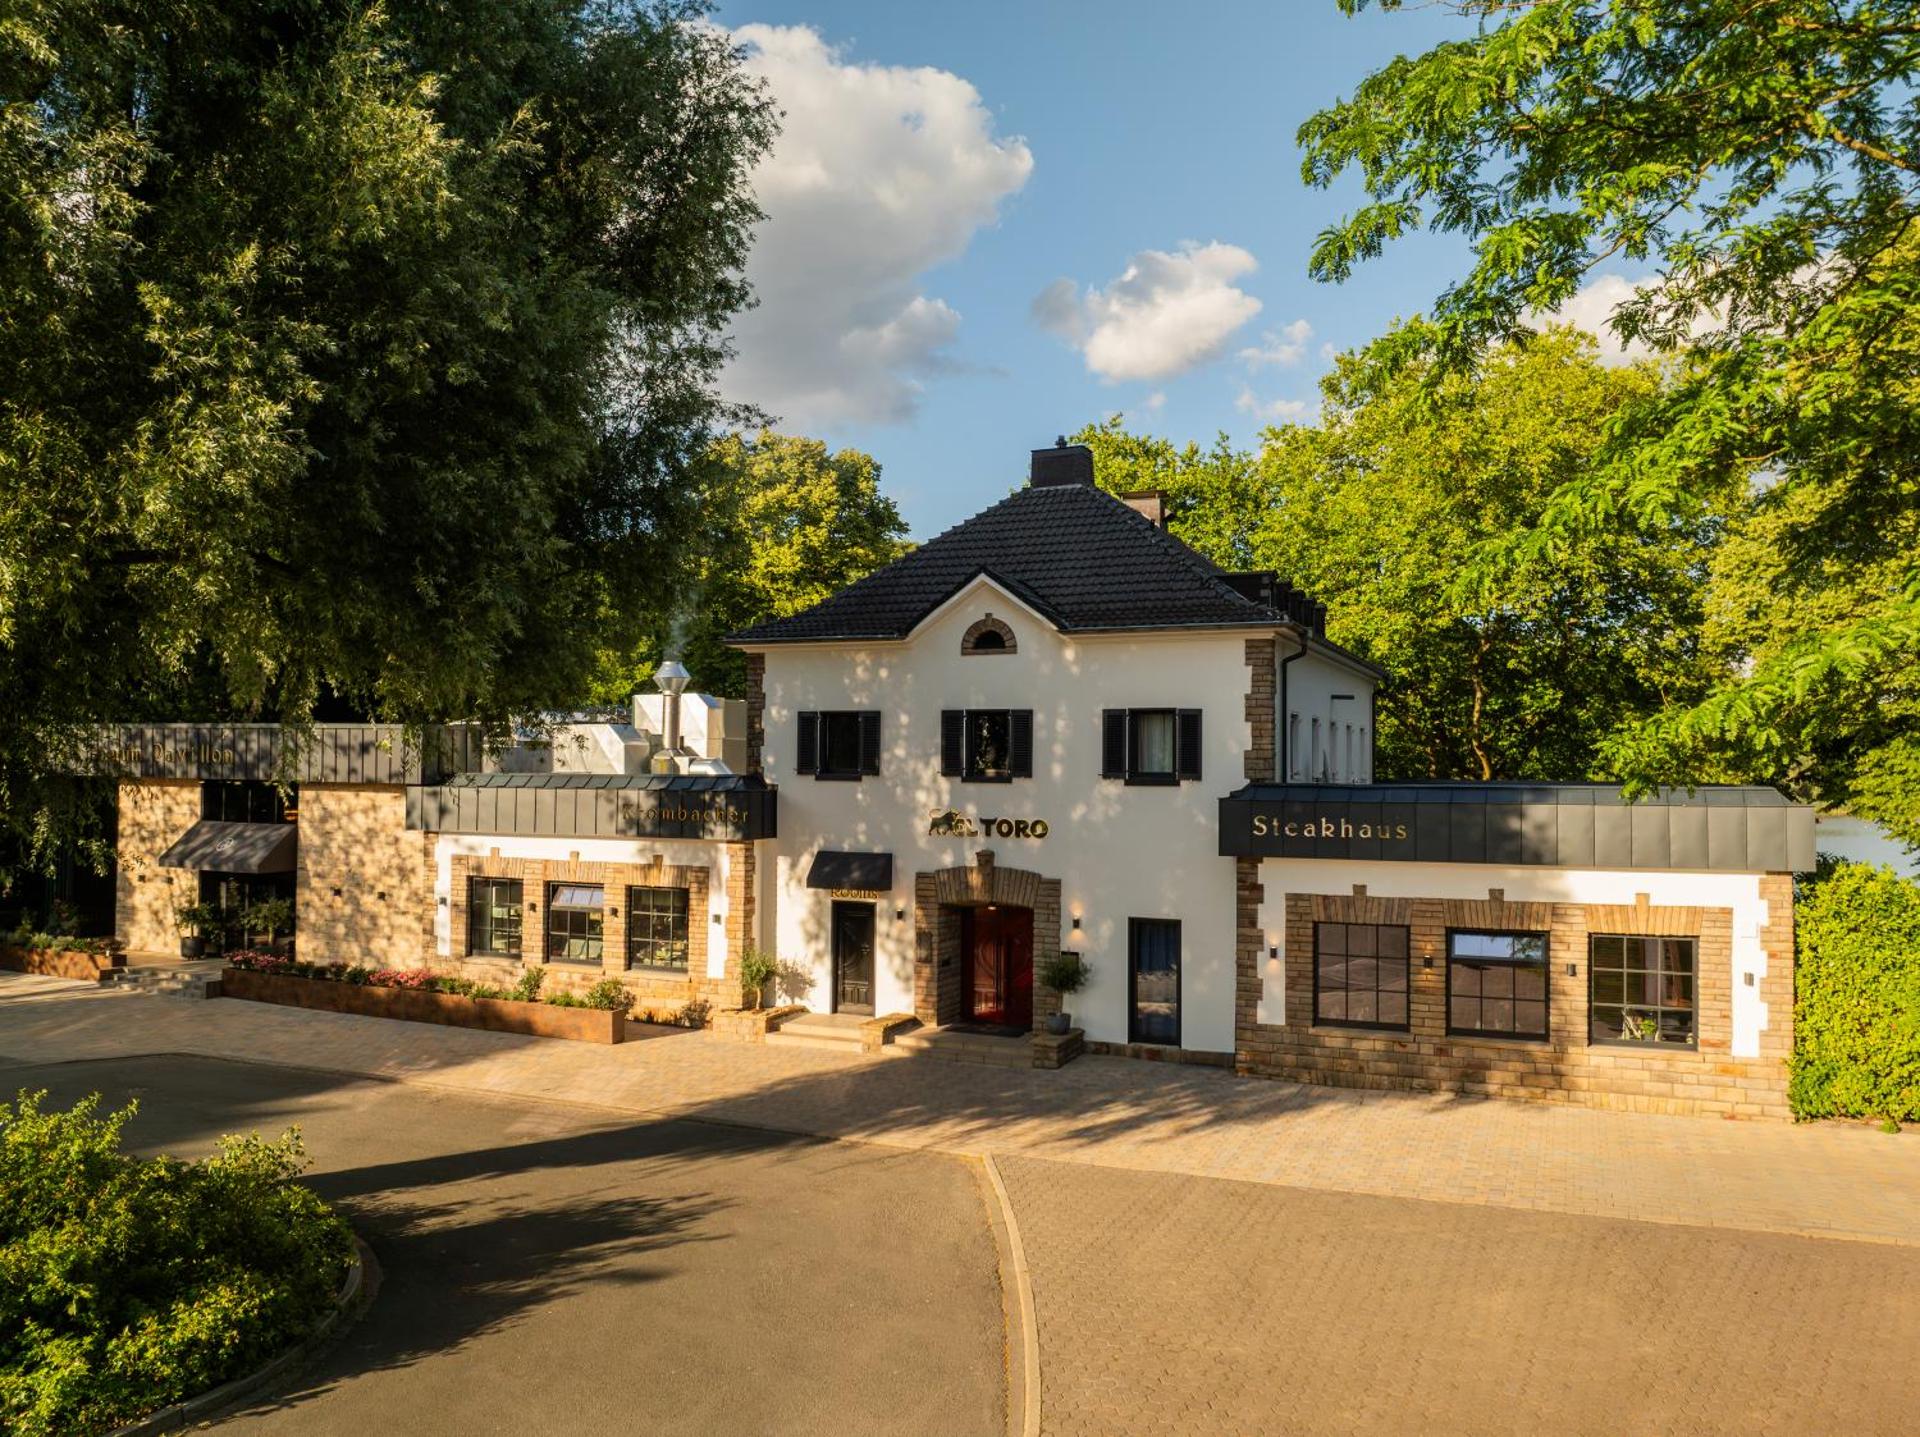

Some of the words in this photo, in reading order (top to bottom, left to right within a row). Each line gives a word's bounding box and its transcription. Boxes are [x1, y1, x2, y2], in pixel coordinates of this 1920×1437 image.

[153, 742, 234, 763] Pavillon
[623, 803, 748, 822] Krombacher
[954, 818, 978, 837] EL
[979, 817, 1048, 838] TORO
[1252, 815, 1408, 839] Steakhaus
